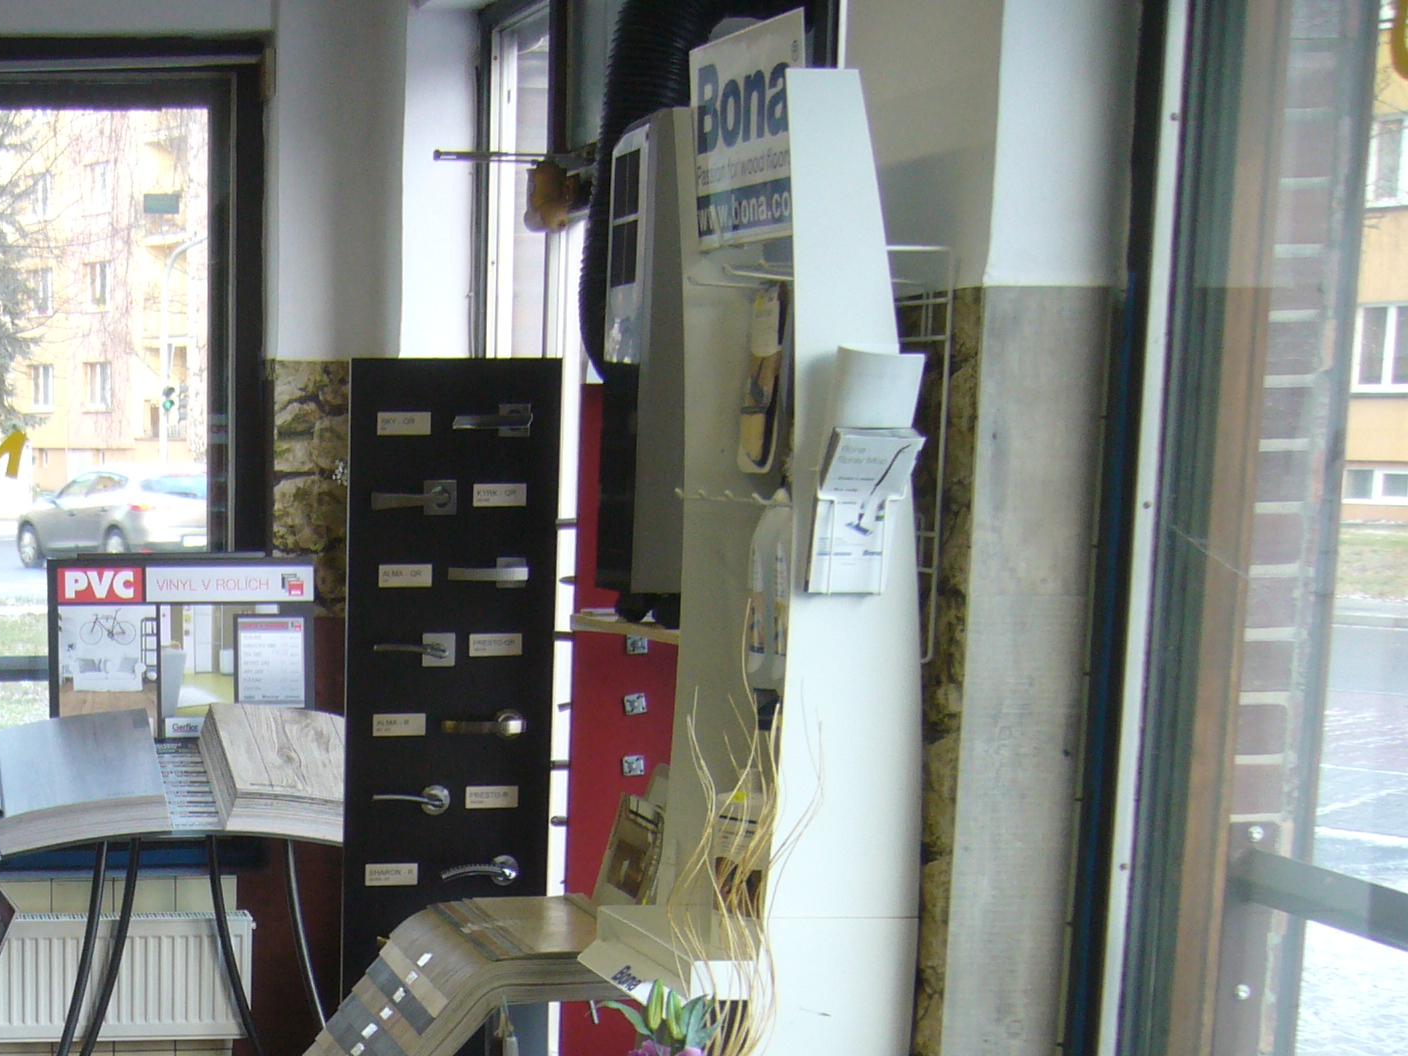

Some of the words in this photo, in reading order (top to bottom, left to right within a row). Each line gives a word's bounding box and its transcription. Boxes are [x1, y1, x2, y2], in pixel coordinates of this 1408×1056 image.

[697, 62, 789, 155] Bona
[64, 570, 135, 600] PVC
[155, 578, 198, 592] VINYL
[201, 578, 213, 591] V
[216, 576, 270, 591] ROLÍCH
[610, 964, 642, 992] Bona
